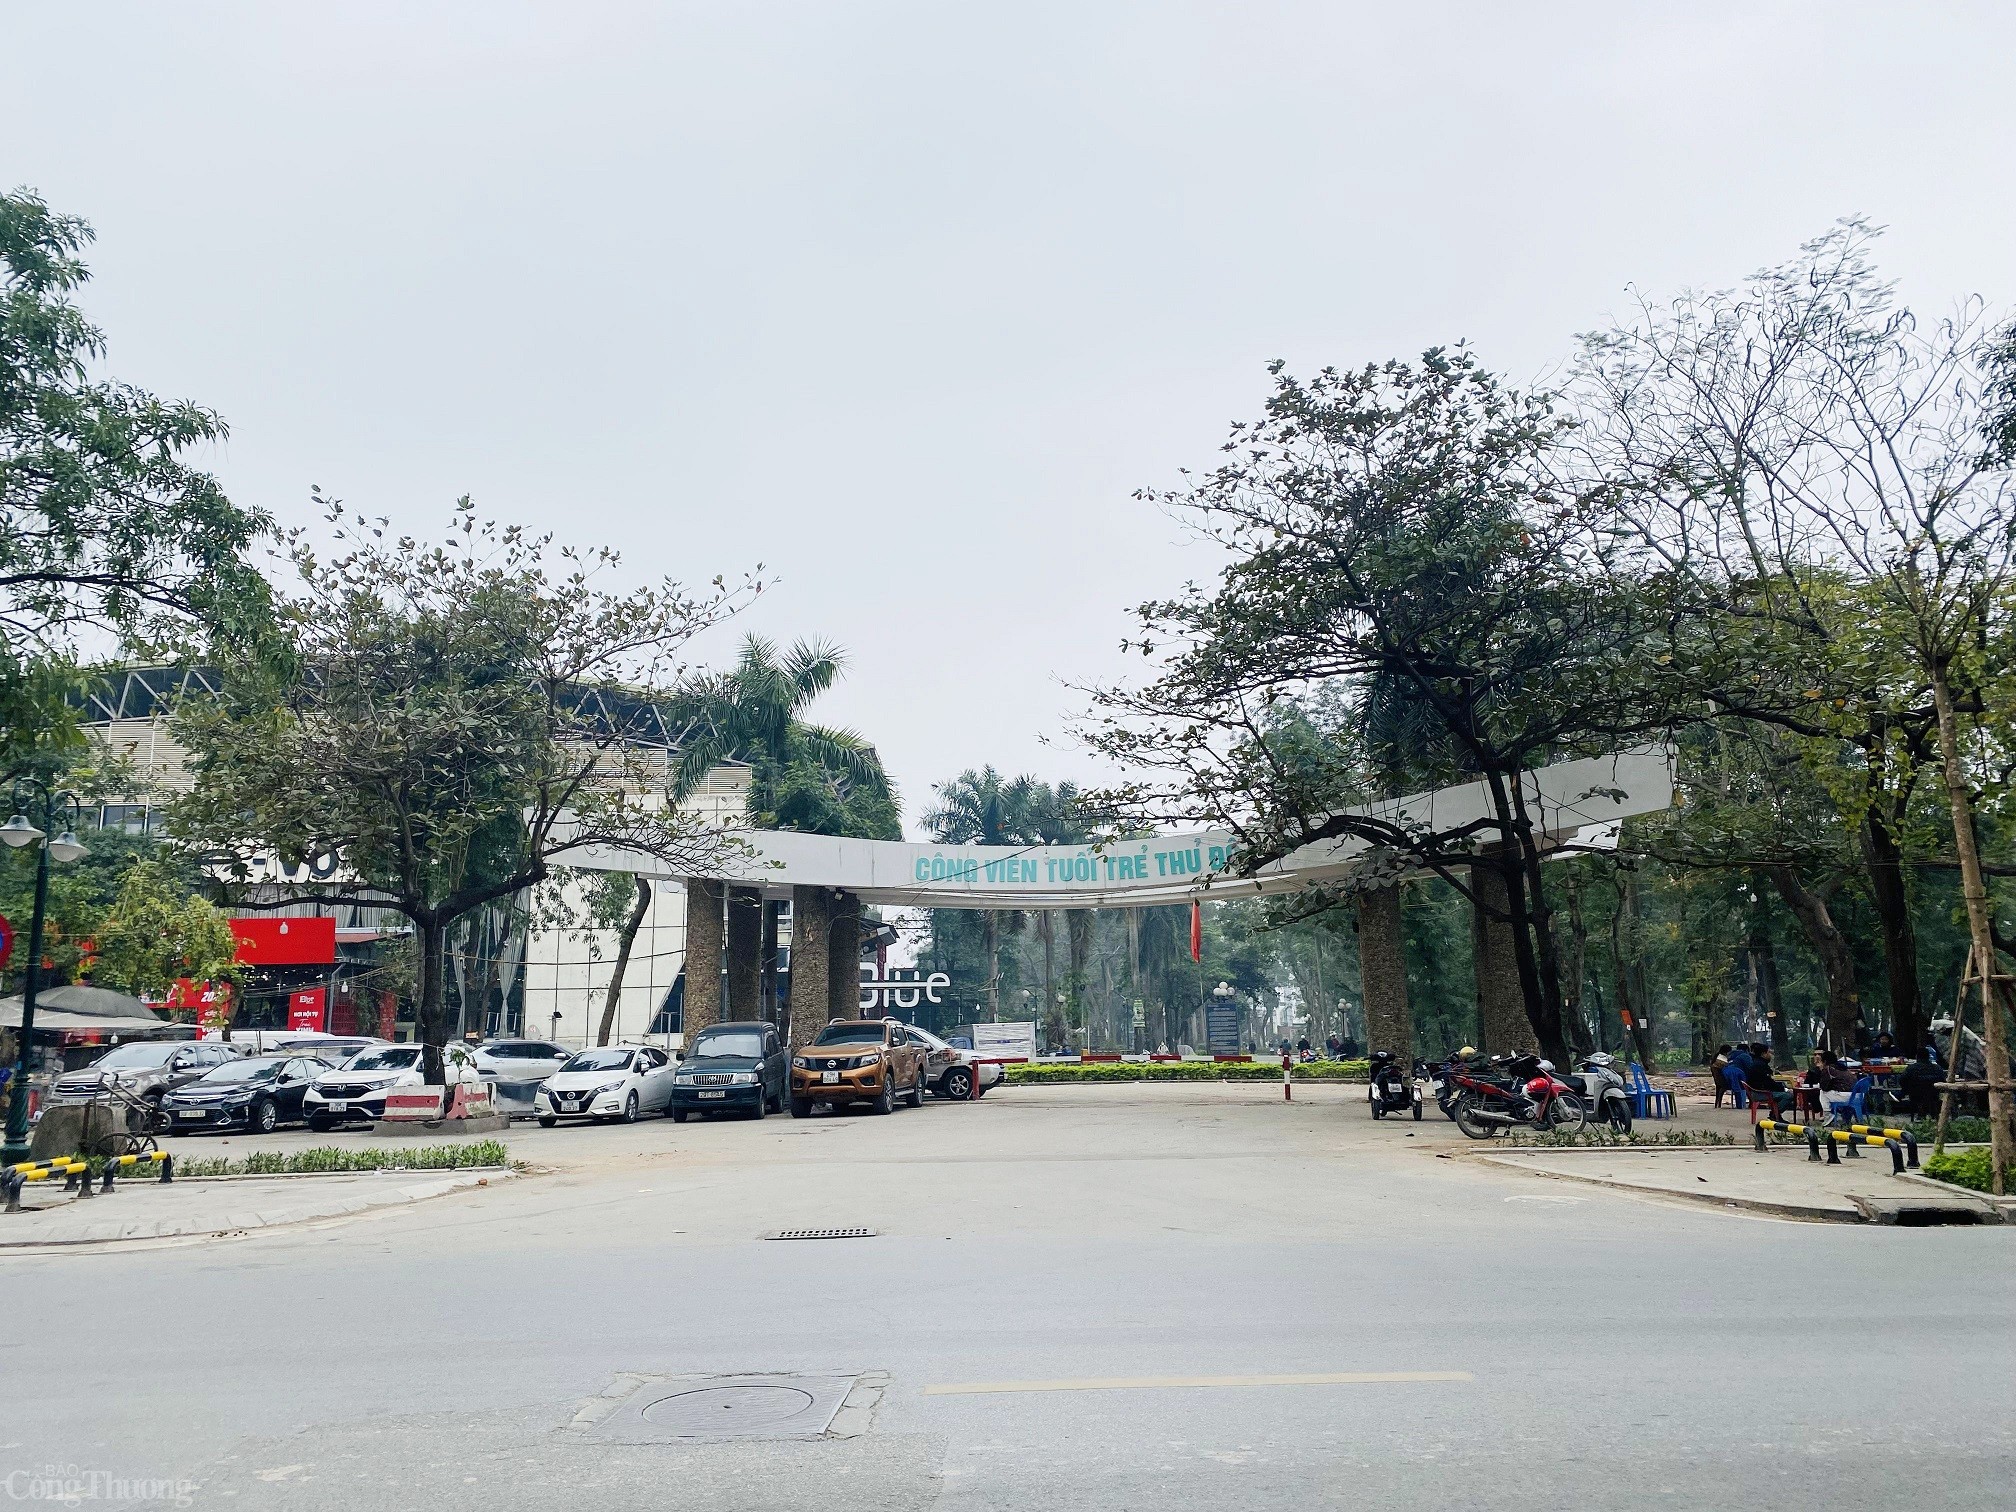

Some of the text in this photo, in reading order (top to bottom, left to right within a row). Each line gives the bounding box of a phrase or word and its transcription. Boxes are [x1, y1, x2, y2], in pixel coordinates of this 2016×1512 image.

[915, 852, 978, 883] CÔNG
[984, 853, 1037, 883] VIÊN
[1047, 847, 1098, 882] TUỔI
[1107, 844, 1149, 881] TRẺ
[1154, 837, 1201, 877] THỦ
